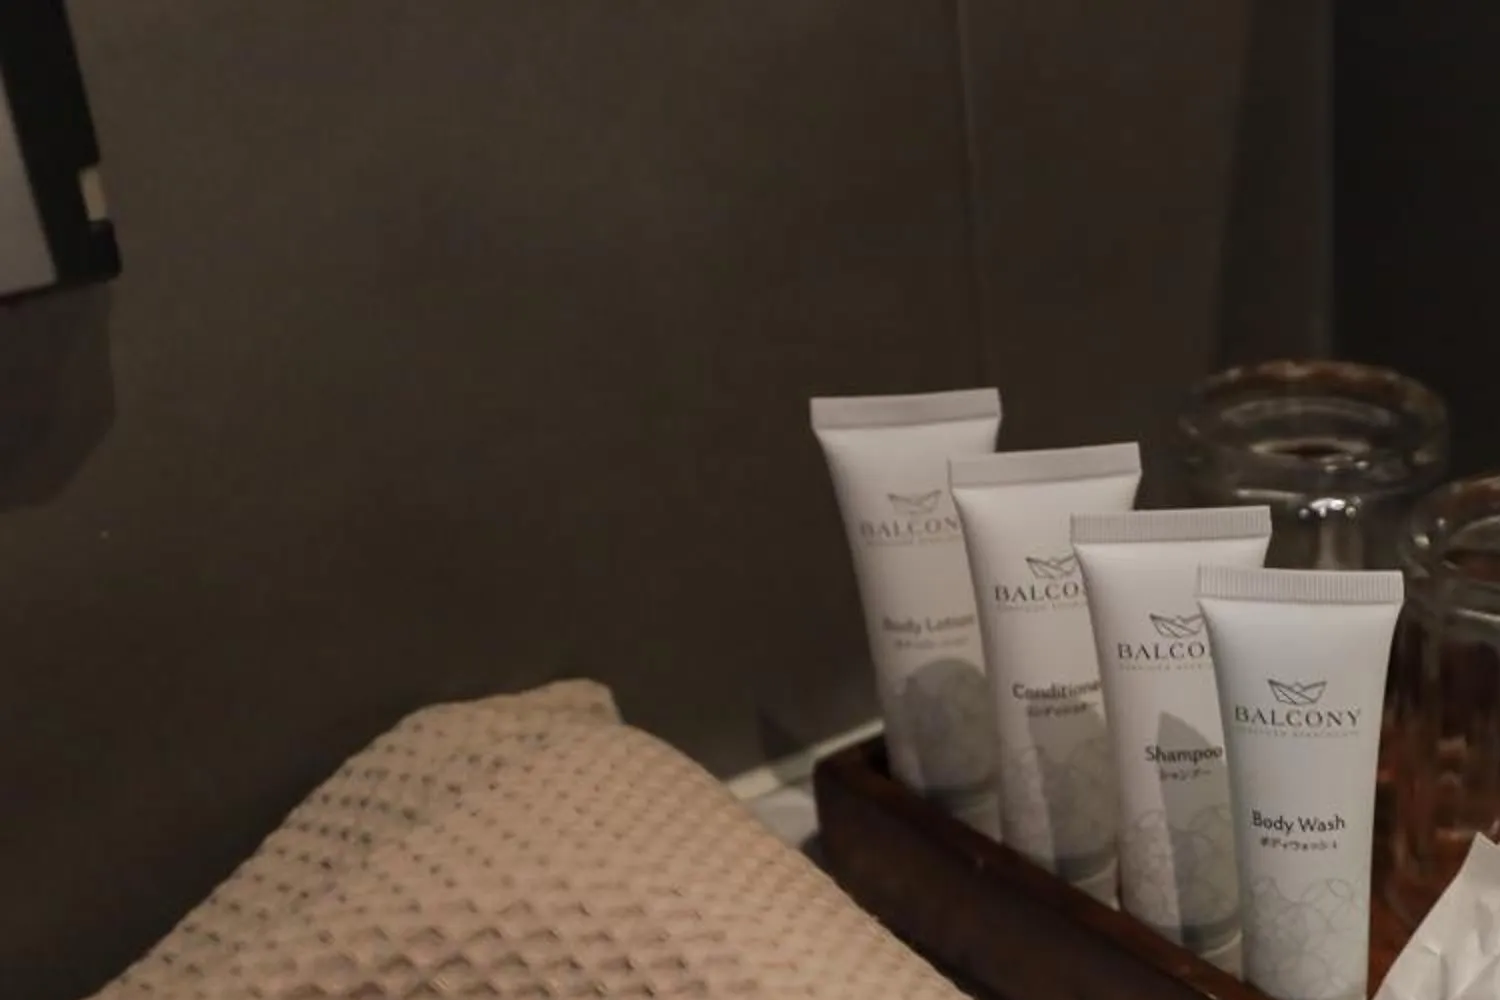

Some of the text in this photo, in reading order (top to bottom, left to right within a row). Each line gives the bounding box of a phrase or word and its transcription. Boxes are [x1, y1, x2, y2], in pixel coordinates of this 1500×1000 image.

[994, 581, 1088, 603] BALCO
[1235, 704, 1362, 728] BALCONY
[1145, 745, 1223, 765] Shampoo
[1252, 810, 1346, 836] Body Wash
